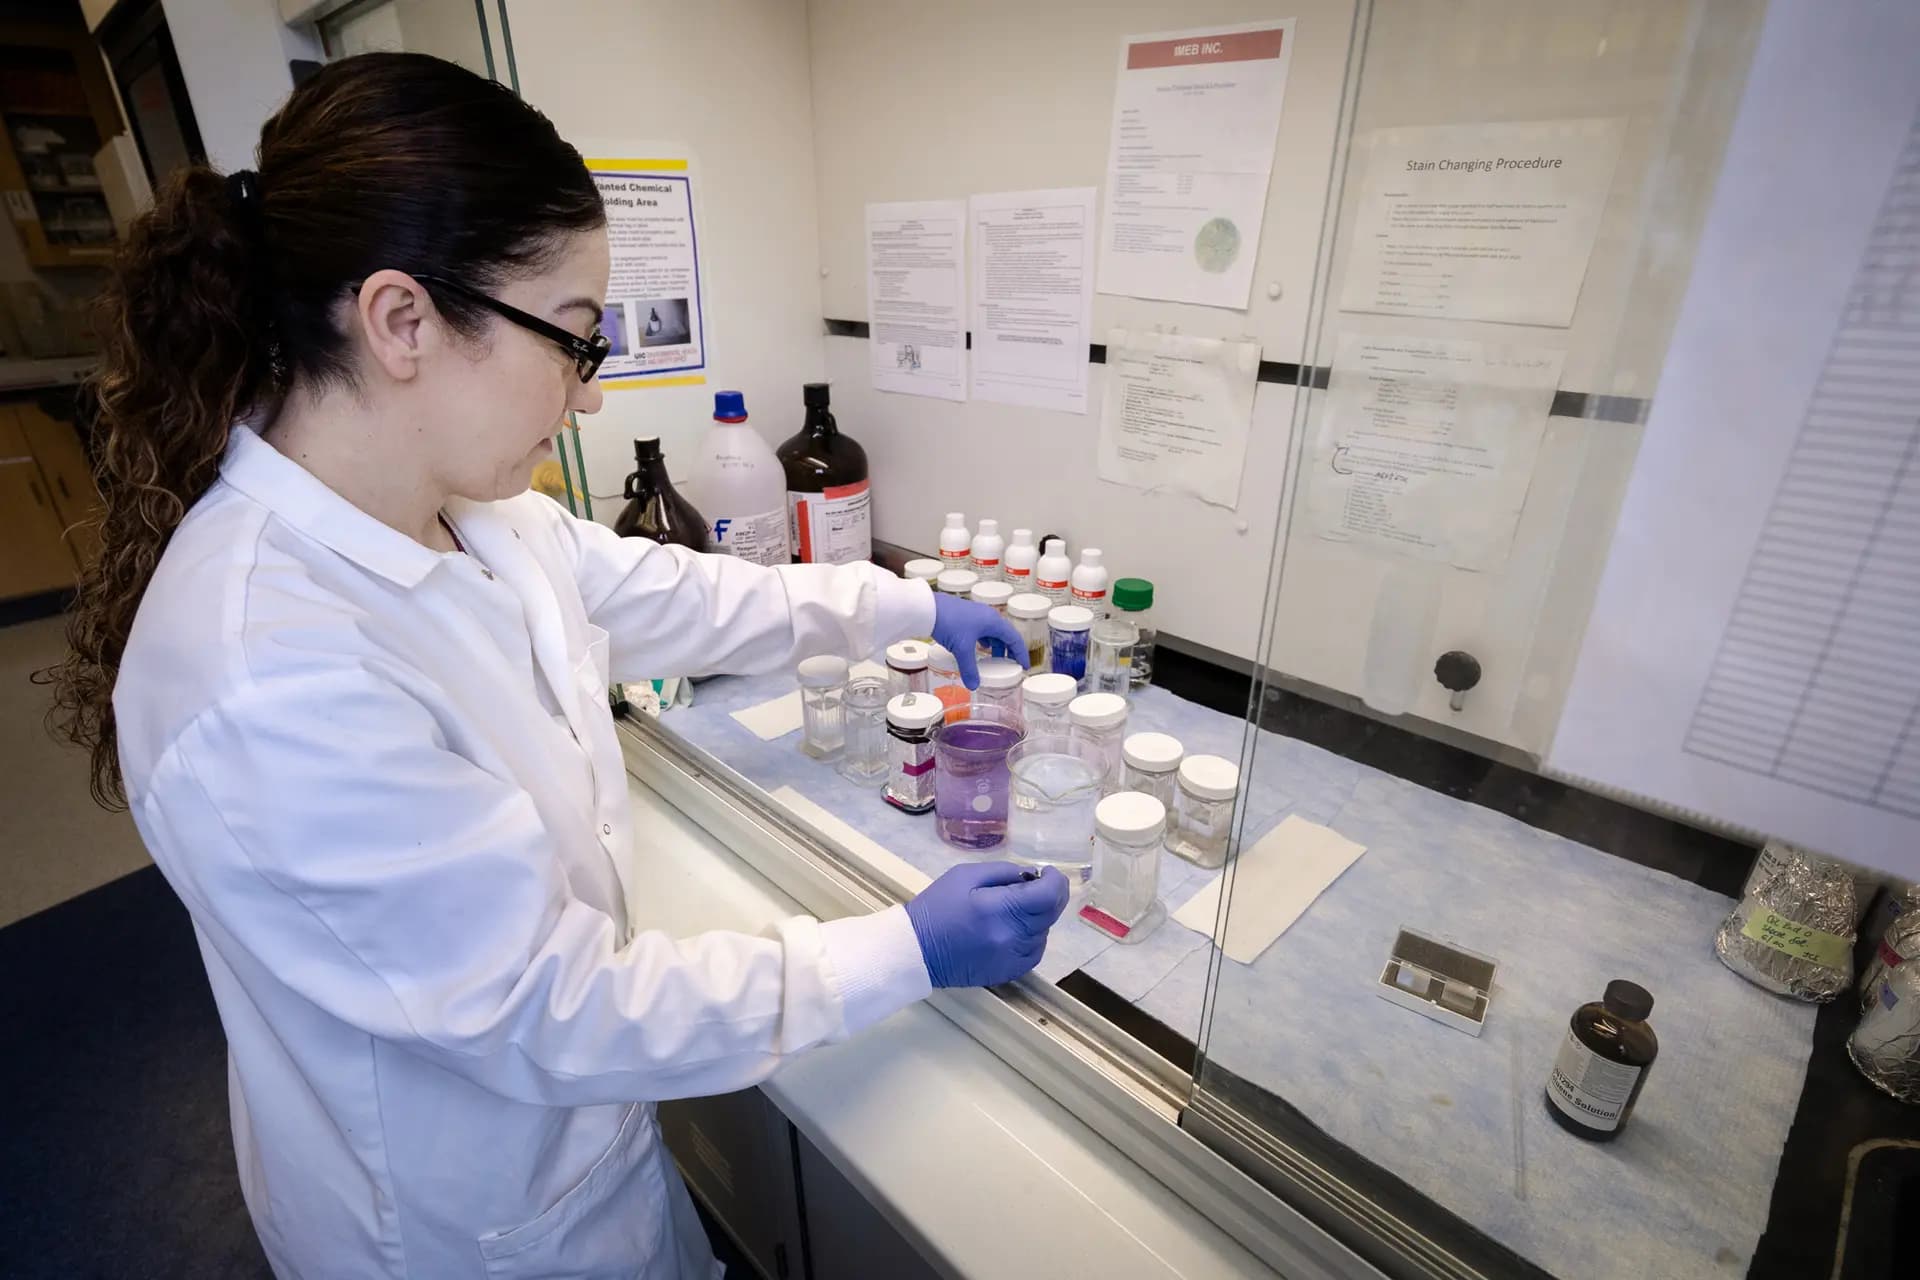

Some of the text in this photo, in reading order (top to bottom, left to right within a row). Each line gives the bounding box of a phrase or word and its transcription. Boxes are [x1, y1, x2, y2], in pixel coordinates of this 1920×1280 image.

[1173, 42, 1223, 57] IMEB INC.
[1406, 157, 1562, 173] Stain Changing Procedure
[628, 183, 672, 193] Chemical
[602, 197, 658, 208] olding Area
[714, 519, 732, 543] F
[1574, 1097, 1616, 1119] Solution
